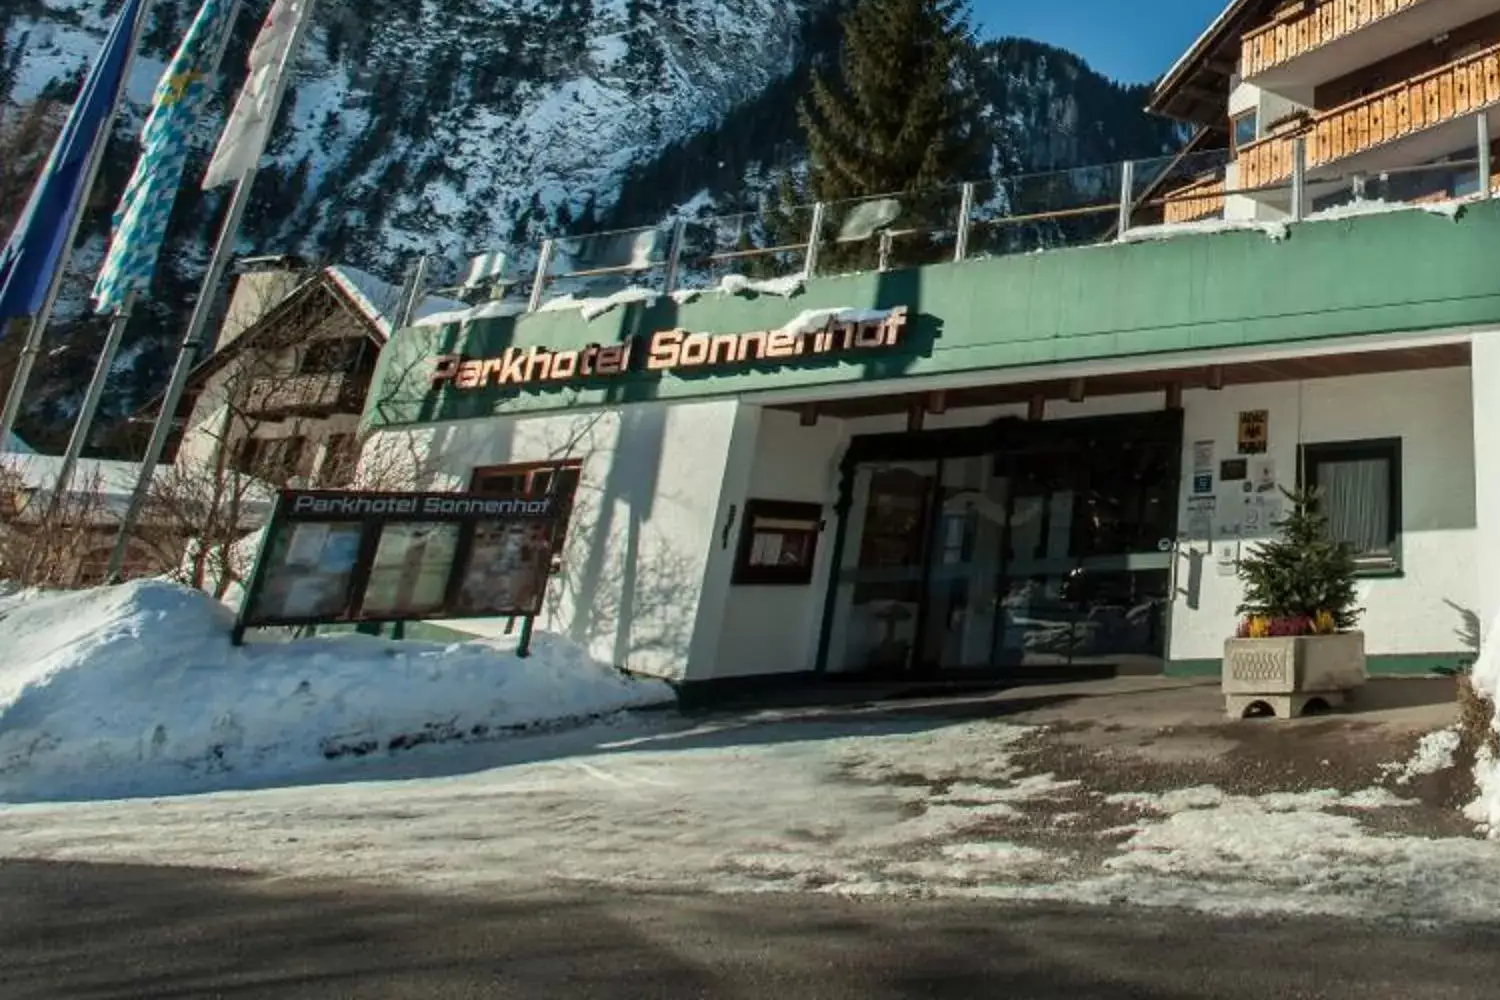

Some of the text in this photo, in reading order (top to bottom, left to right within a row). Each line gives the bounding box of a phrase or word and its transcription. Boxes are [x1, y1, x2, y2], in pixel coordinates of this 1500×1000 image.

[424, 335, 632, 389] Parkhotel
[293, 496, 551, 513] Parkhotel Sonnenhof
